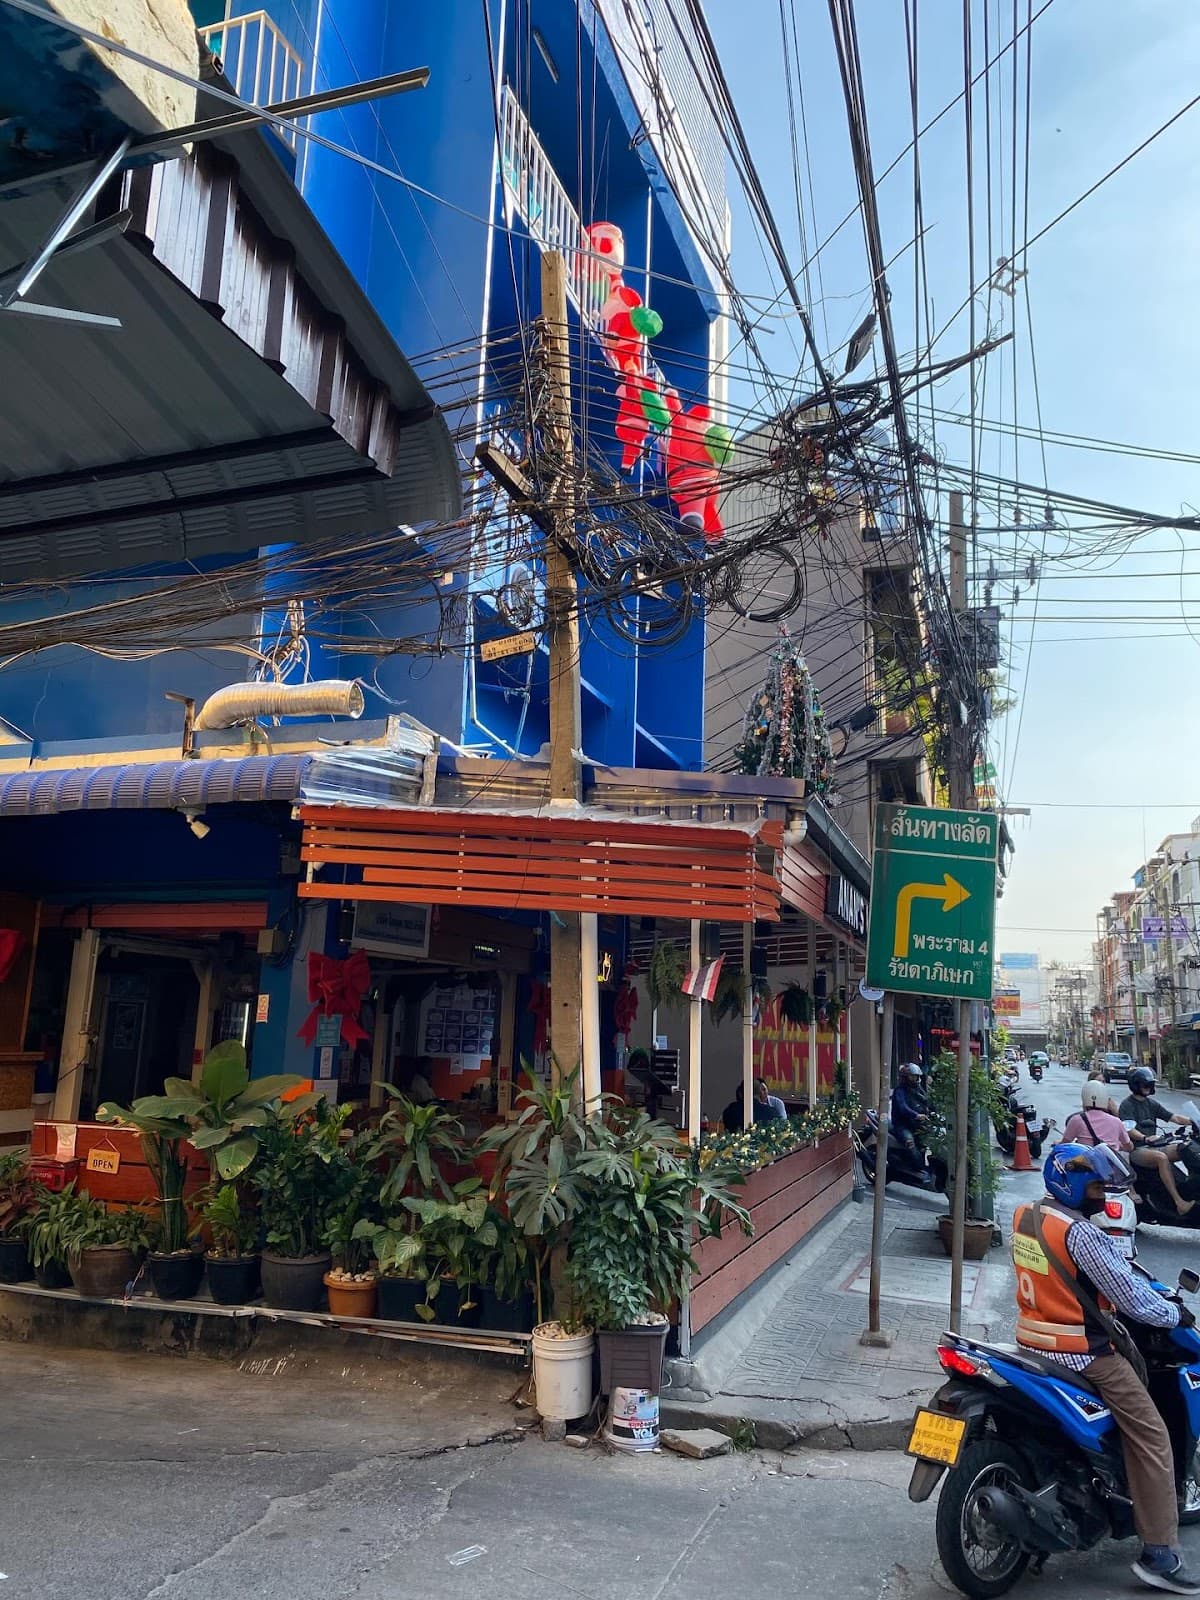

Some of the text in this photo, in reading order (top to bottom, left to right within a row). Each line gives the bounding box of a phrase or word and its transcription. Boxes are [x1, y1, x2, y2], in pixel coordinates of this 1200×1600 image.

[883, 809, 991, 845] ส้นทางลัด
[913, 934, 989, 956] พระราม 4
[93, 1158, 114, 1170] OPEN
[633, 1426, 654, 1439] TOA
